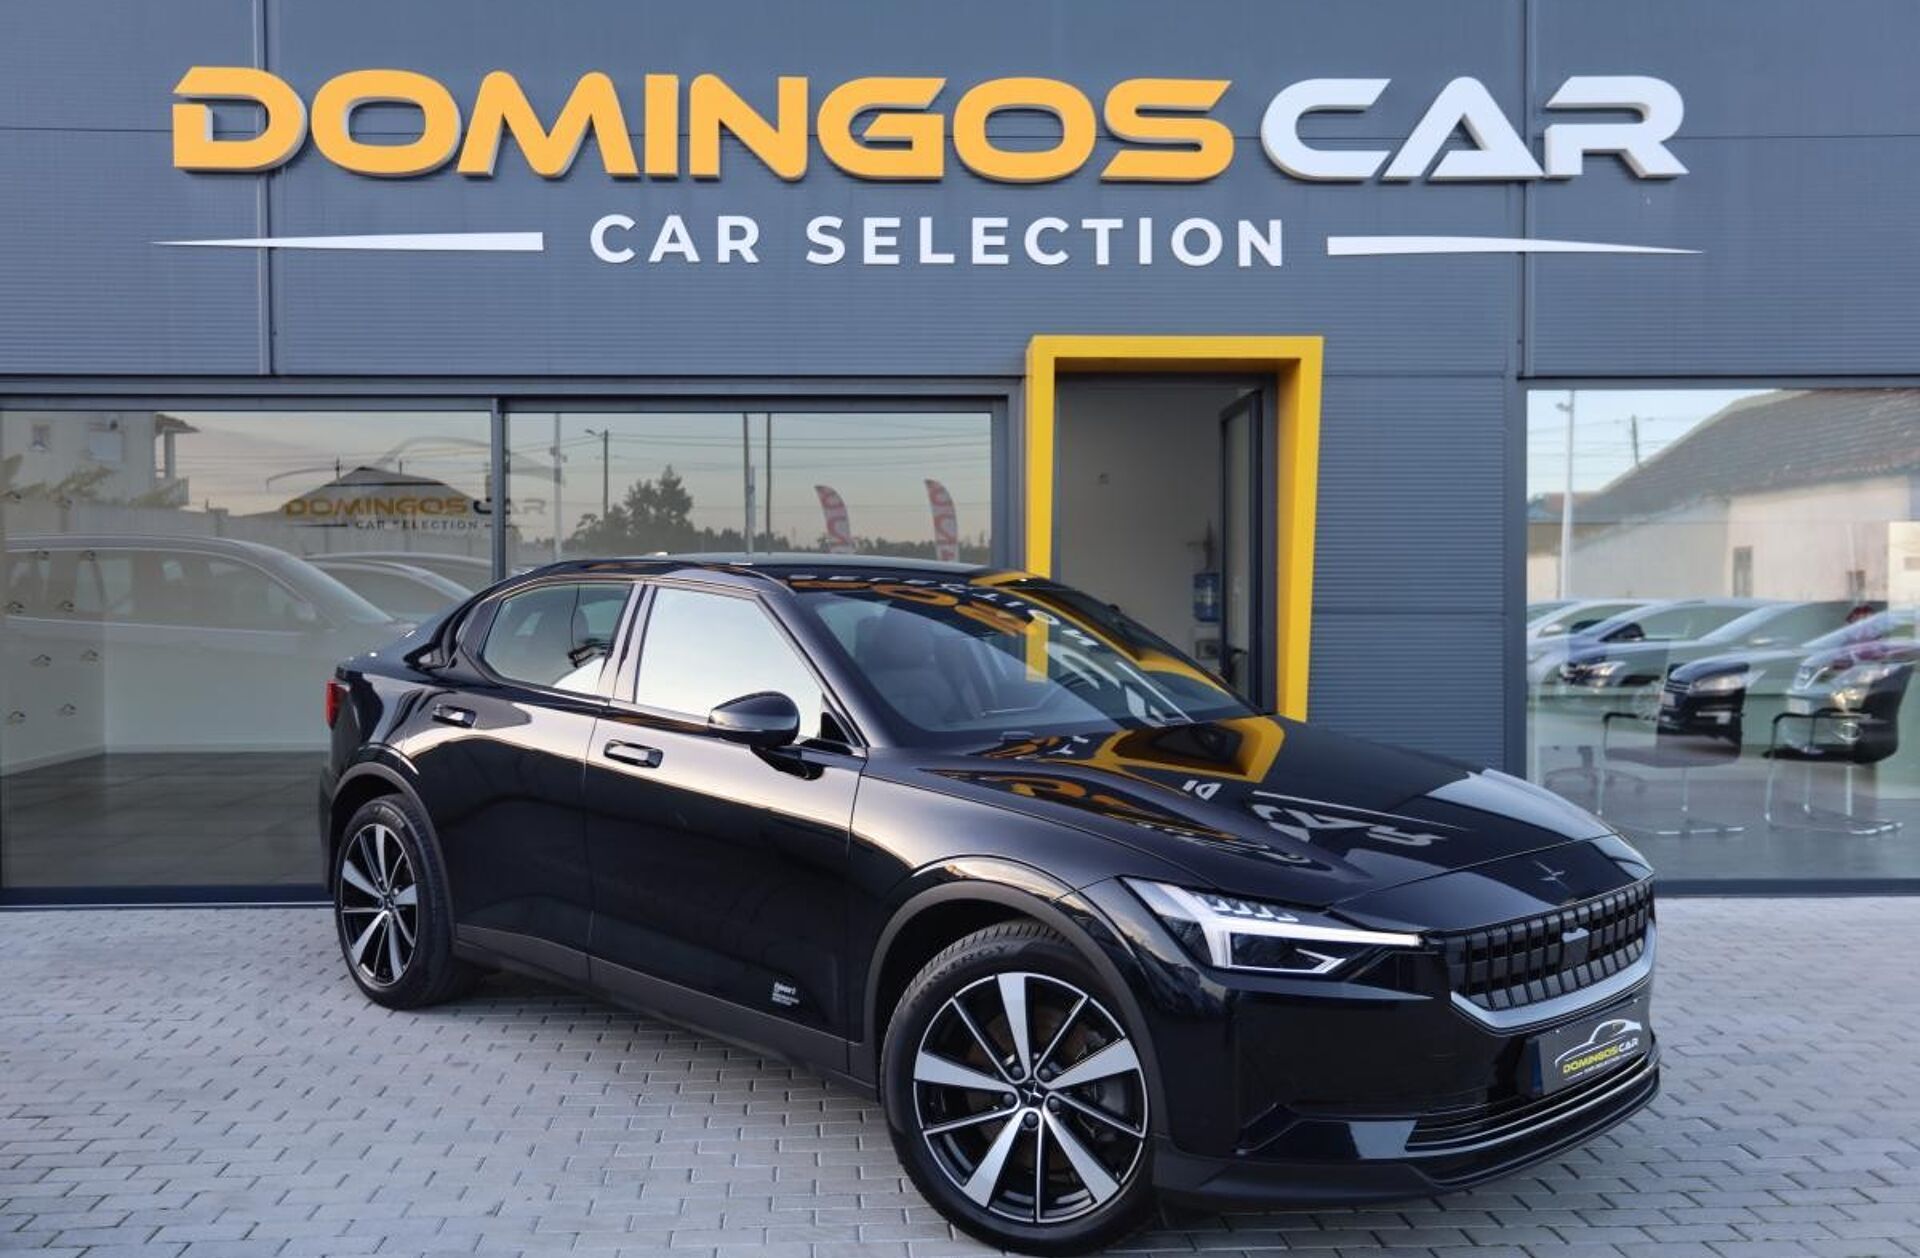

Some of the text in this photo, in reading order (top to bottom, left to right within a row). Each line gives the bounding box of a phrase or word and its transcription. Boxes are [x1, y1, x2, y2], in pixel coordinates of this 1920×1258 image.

[172, 66, 1689, 182] DOMINGOS CAR
[590, 214, 1283, 267] CAR SELECTION
[286, 497, 468, 516] DOMINGOS
